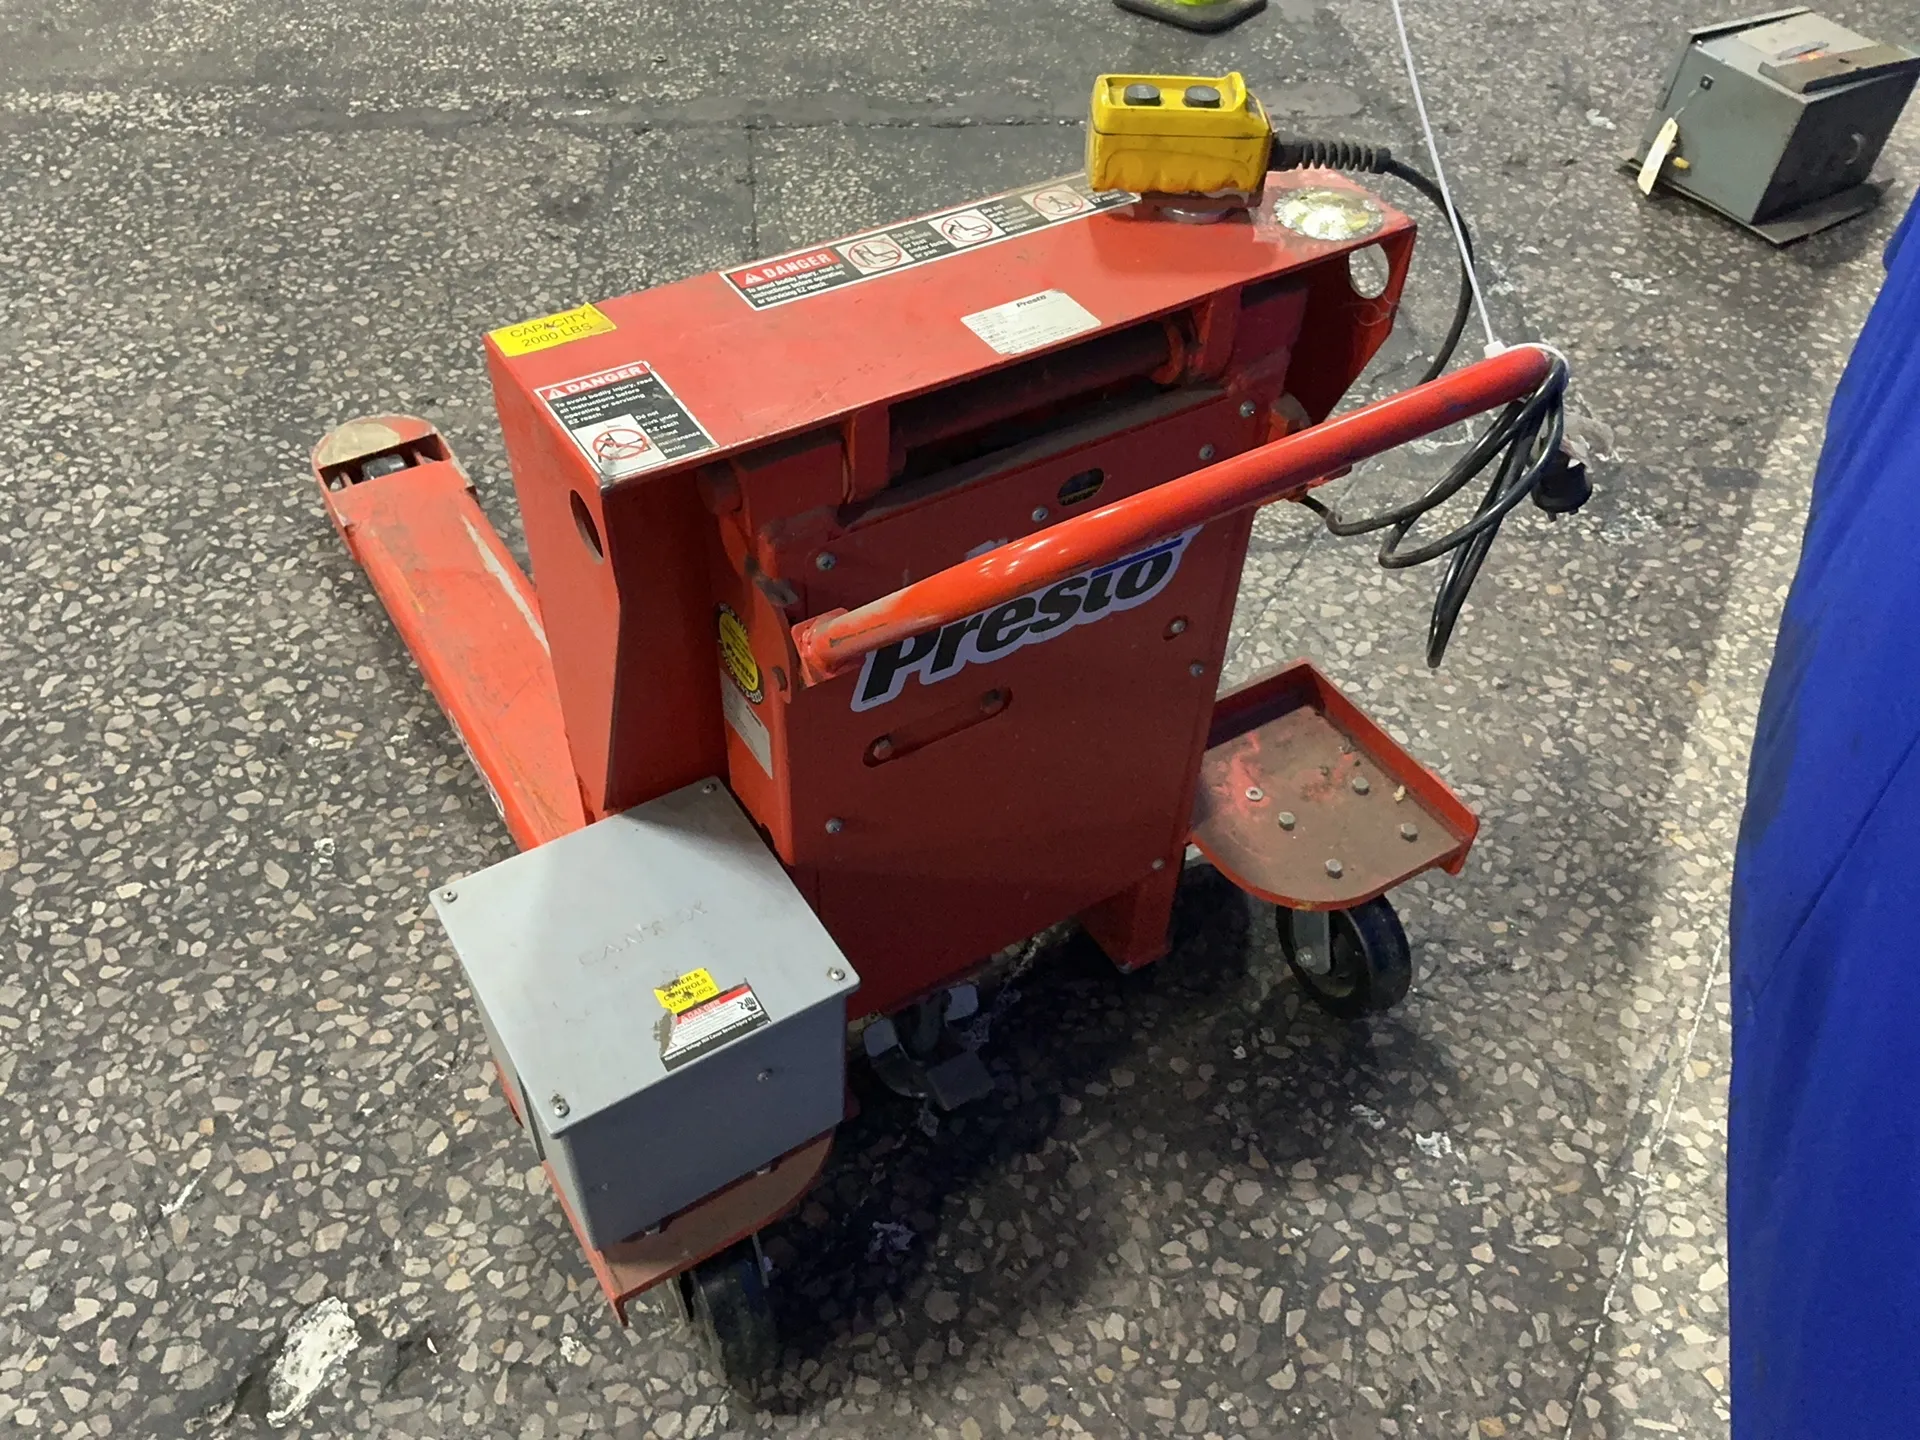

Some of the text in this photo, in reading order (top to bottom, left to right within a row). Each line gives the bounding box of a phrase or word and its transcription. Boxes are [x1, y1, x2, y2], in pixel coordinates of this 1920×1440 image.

[762, 253, 832, 278] DANGER
[756, 282, 775, 291] avoid
[775, 277, 797, 286] bodily
[818, 266, 835, 274] read
[790, 279, 813, 288] before
[813, 270, 845, 282] operating
[765, 290, 798, 302] servicing
[1016, 294, 1047, 308] Presto
[510, 311, 587, 338] CAPACITY
[521, 323, 593, 347] 2000 LBS
[565, 366, 644, 393] DANGER
[566, 395, 587, 405] avoid
[588, 389, 612, 399] bodily
[612, 383, 636, 393] injury,
[636, 377, 653, 385] read
[564, 406, 600, 420] operating
[611, 393, 646, 406] servicing
[570, 395, 615, 411] instructions
[615, 388, 640, 398] before
[580, 412, 604, 421] reach.
[659, 412, 679, 421] under
[660, 421, 680, 430] reach
